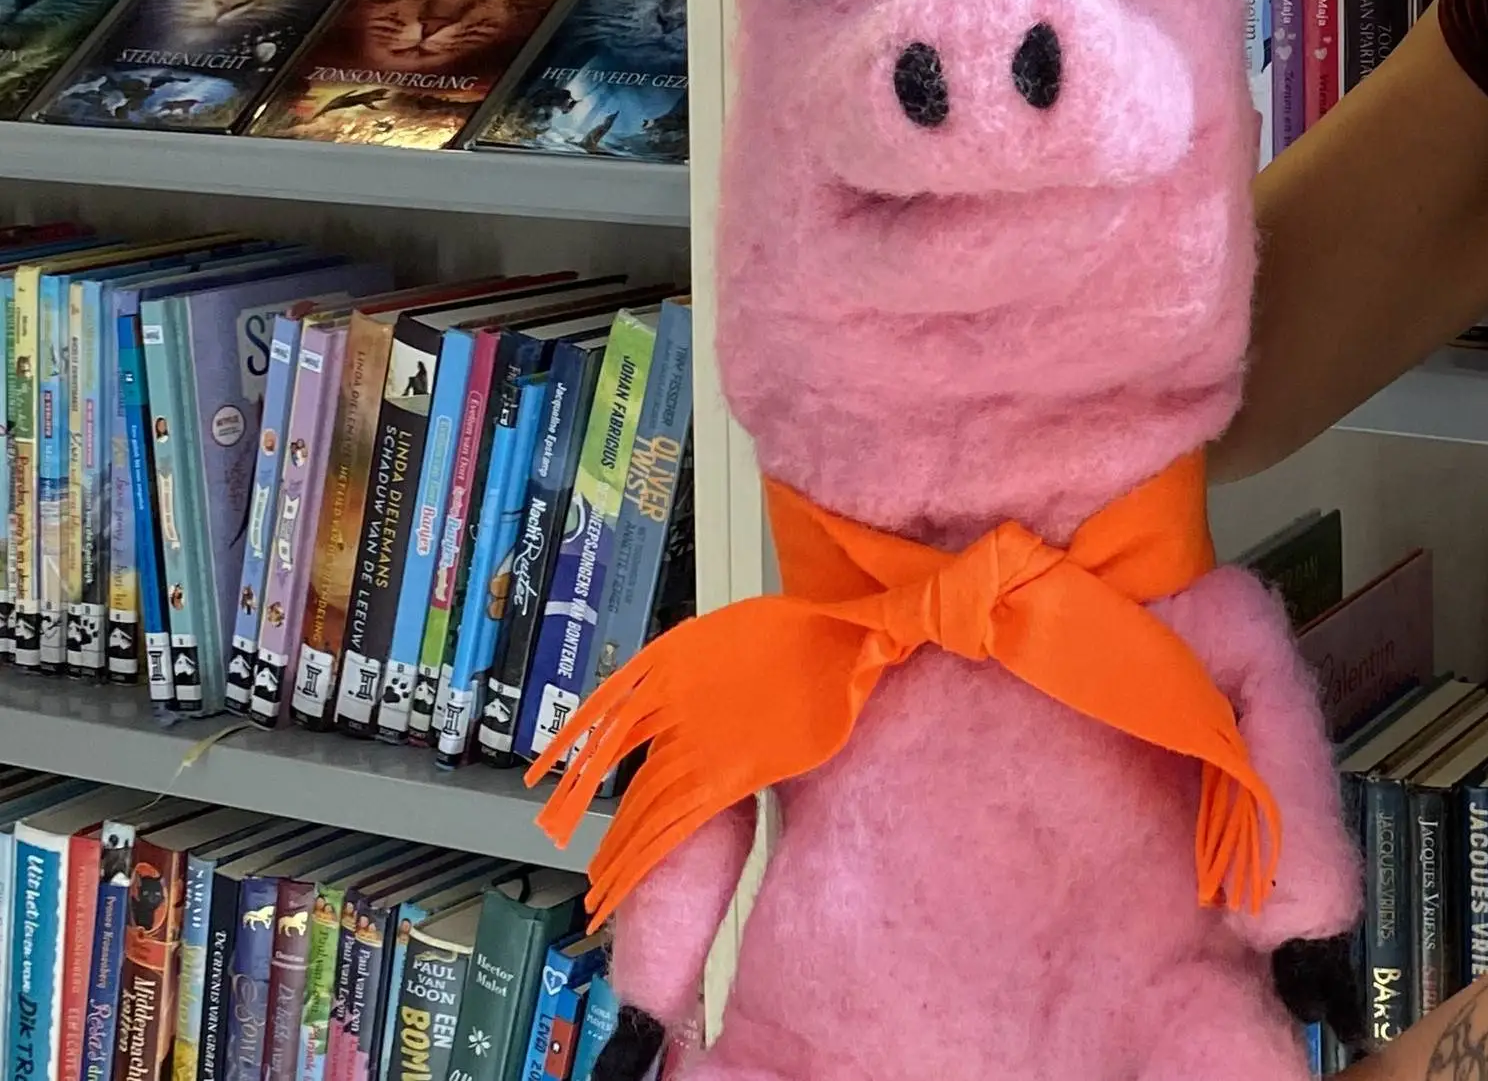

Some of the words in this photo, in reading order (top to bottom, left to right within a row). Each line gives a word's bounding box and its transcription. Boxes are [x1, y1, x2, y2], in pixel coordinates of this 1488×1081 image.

[117, 48, 251, 70] STERRENLICHT
[543, 67, 573, 82] HET
[304, 66, 481, 91] ZONSONDERGANG
[614, 355, 637, 400] JOHAN
[547, 381, 568, 433] Jacqueline
[601, 402, 627, 470] FABRICIUS
[373, 424, 398, 516] SCHADUW
[392, 430, 412, 482] LINDA
[538, 434, 557, 478] Epskamp
[624, 435, 657, 511] TWIST
[643, 435, 680, 523] OLIVER
[365, 520, 382, 555] VAN
[375, 489, 401, 589] DIELEMANS
[417, 506, 436, 554] Banjer
[360, 560, 374, 585] DE
[350, 589, 370, 649] LEEUW
[569, 596, 588, 621] VAN
[556, 621, 581, 679] BONTEKOE
[1379, 811, 1395, 887] JACQUES
[1418, 816, 1438, 889] JACQUES
[27, 855, 46, 888] Uit
[25, 890, 42, 918] het
[1378, 888, 1396, 940] VRIENS
[1422, 893, 1441, 951] VRIENS
[342, 934, 356, 961] Paul
[355, 949, 371, 977] Paul
[340, 964, 352, 985] van
[413, 960, 457, 982] PAUL
[417, 974, 446, 991] VAN
[476, 973, 508, 998] Malot
[477, 954, 514, 983] Hector
[335, 987, 351, 1019] Loon
[354, 978, 366, 999] van
[406, 981, 457, 1005] LOON
[349, 1001, 364, 1032] Loon
[433, 1013, 458, 1050] EEN
